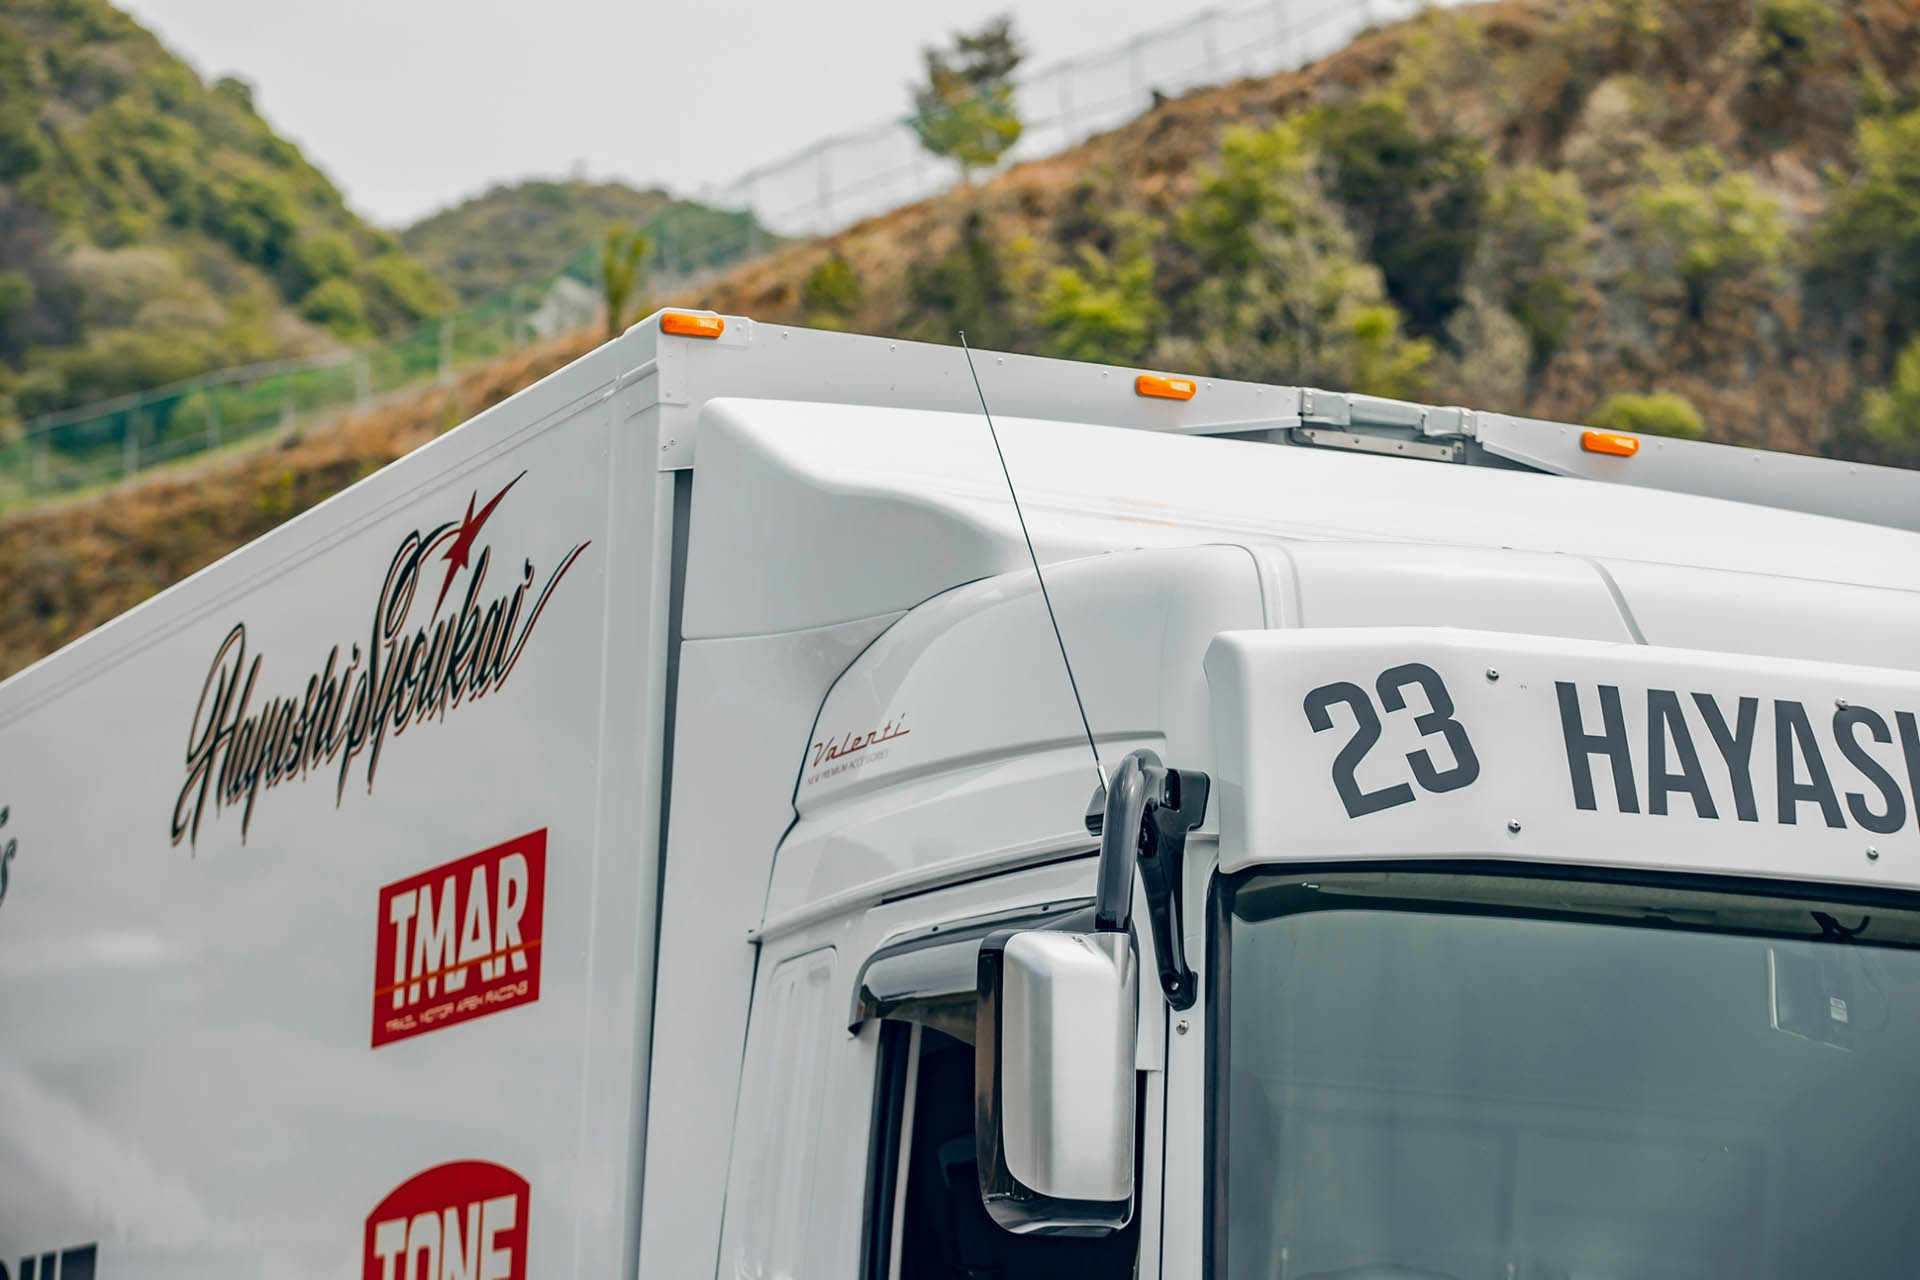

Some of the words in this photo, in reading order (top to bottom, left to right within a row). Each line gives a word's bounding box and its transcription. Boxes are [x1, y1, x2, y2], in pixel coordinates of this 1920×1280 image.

[813, 712, 911, 768] Valenti
[1303, 662, 1480, 819] 23
[1555, 681, 1920, 834] HAYAS
[390, 852, 528, 1011] TMAR
